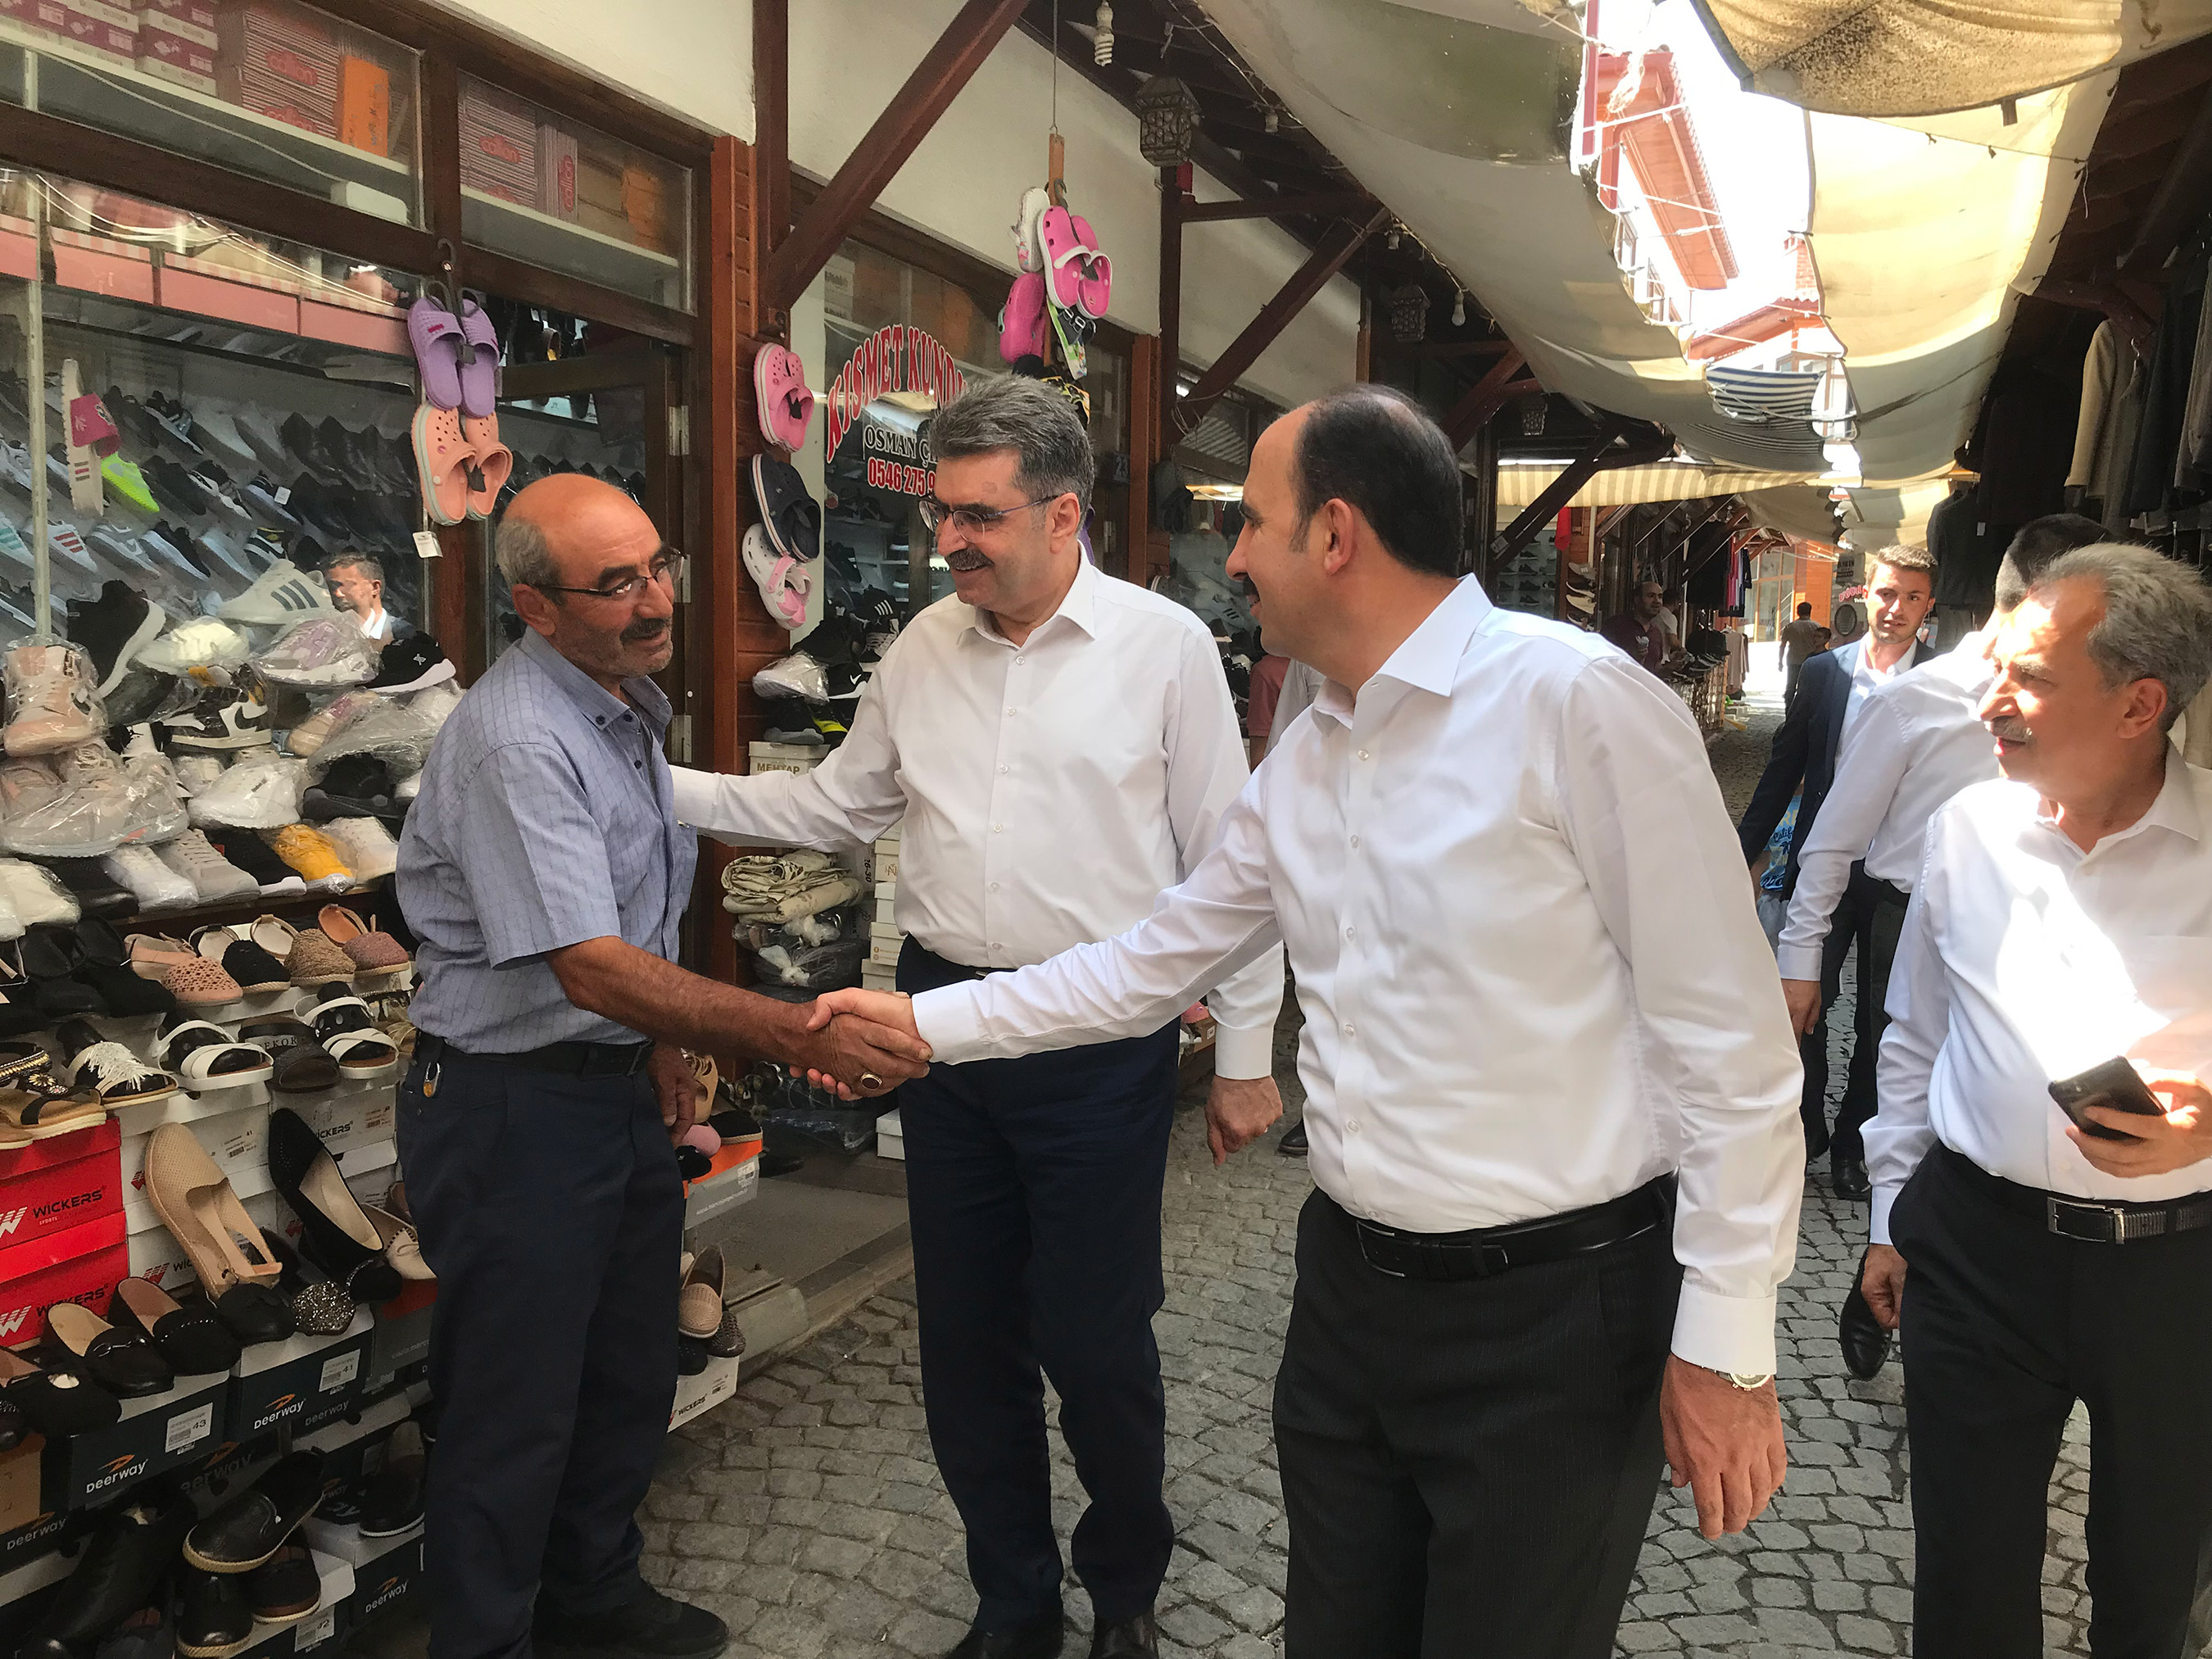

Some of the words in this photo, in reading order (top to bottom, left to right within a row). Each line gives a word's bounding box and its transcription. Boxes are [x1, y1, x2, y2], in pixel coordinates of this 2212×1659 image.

[827, 324, 904, 465] KISMET
[864, 424, 917, 459] OSMAN
[867, 456, 902, 492] 0546
[903, 465, 926, 496] 275
[33, 1188, 103, 1219] WICKERS
[192, 1419, 206, 1430] 43
[253, 1399, 305, 1430] Deerway
[85, 1460, 147, 1494] Deerway
